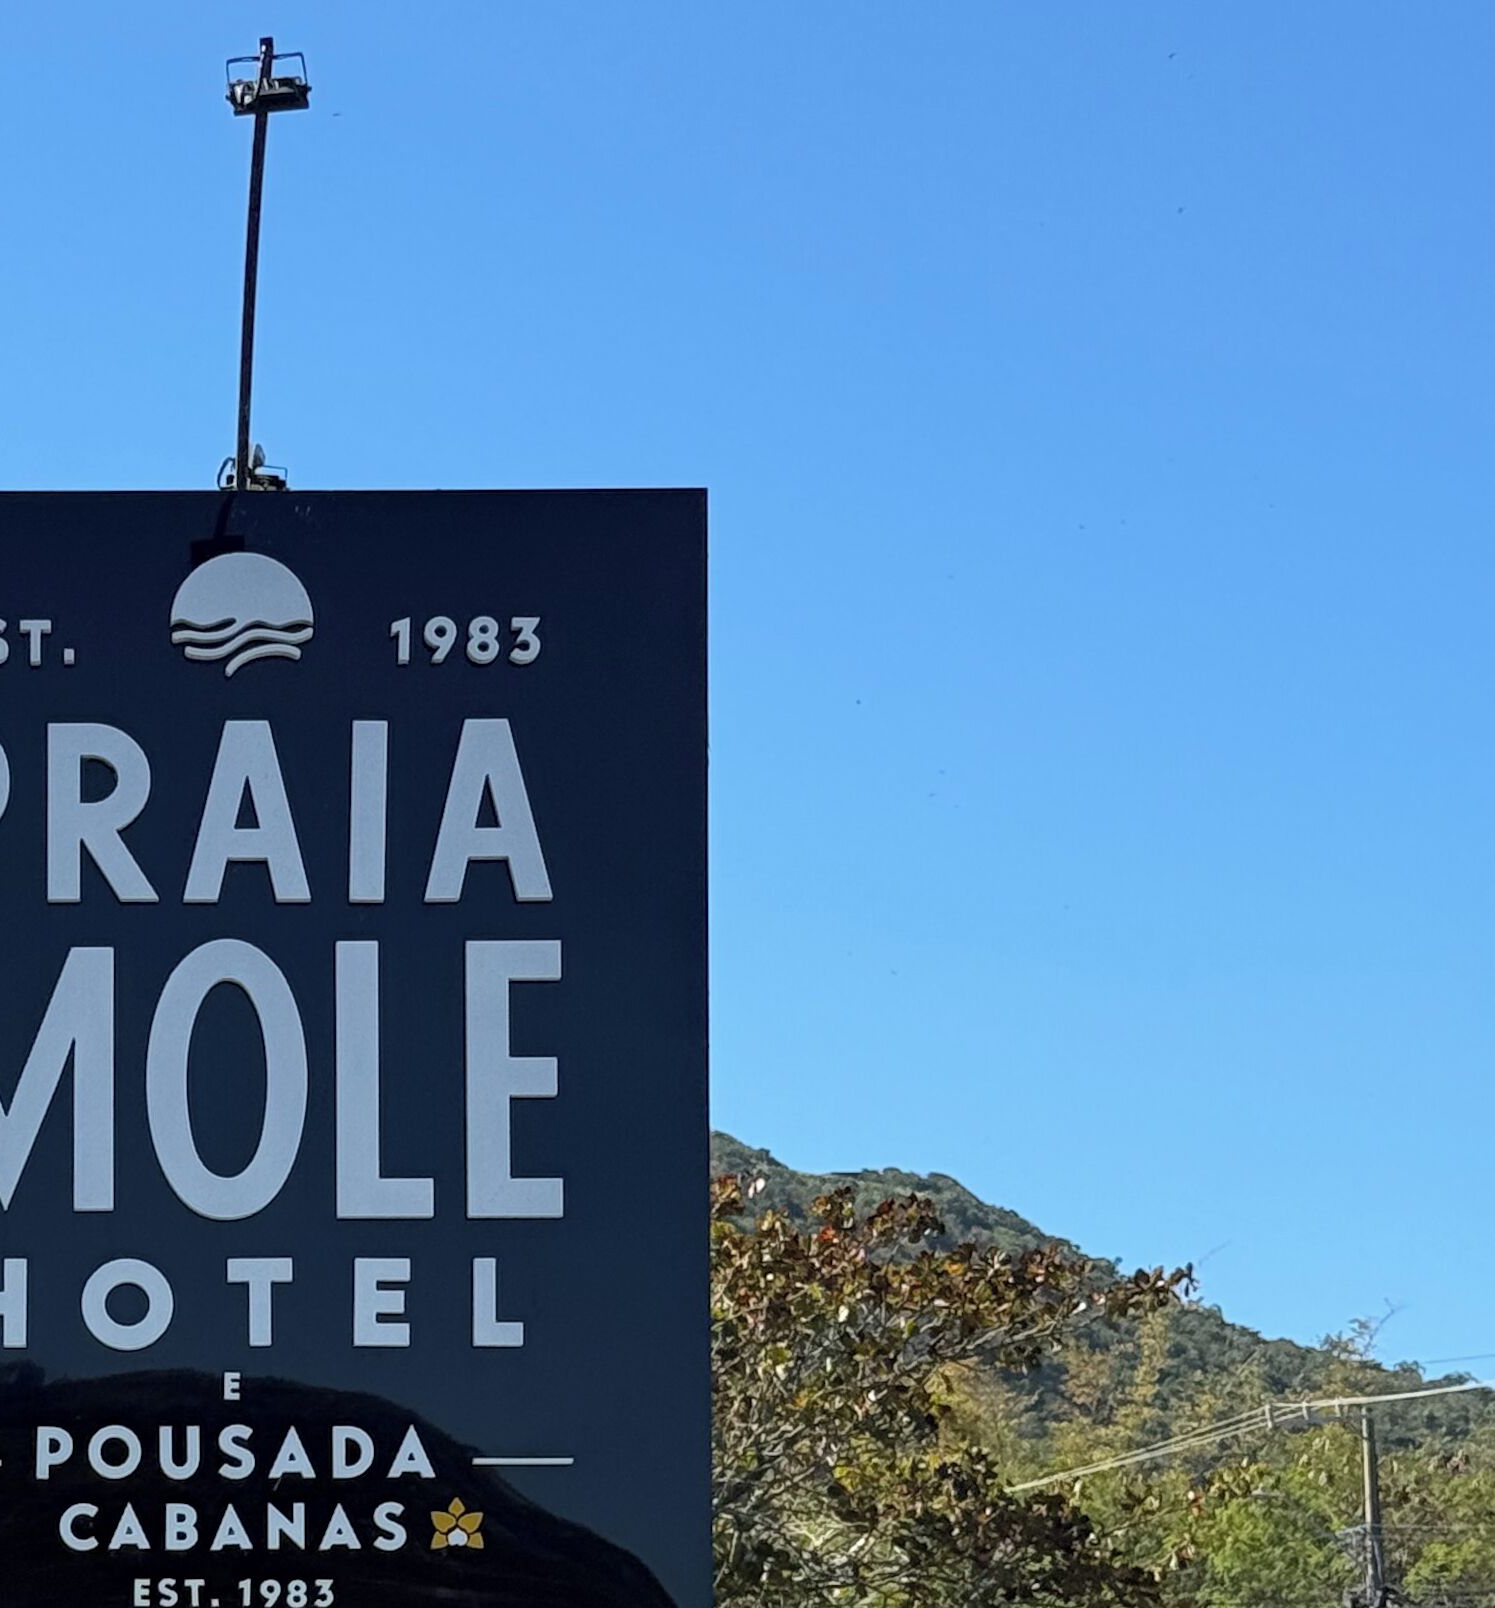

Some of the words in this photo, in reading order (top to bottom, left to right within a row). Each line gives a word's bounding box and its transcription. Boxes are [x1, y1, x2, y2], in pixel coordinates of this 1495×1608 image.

[390, 615, 541, 665] 1983
[223, 1371, 241, 1401] E
[35, 1424, 436, 1480] POUSADA
[59, 1501, 407, 1551] CABANAS
[133, 1577, 220, 1608] EST.
[238, 1577, 334, 1608] 1983
